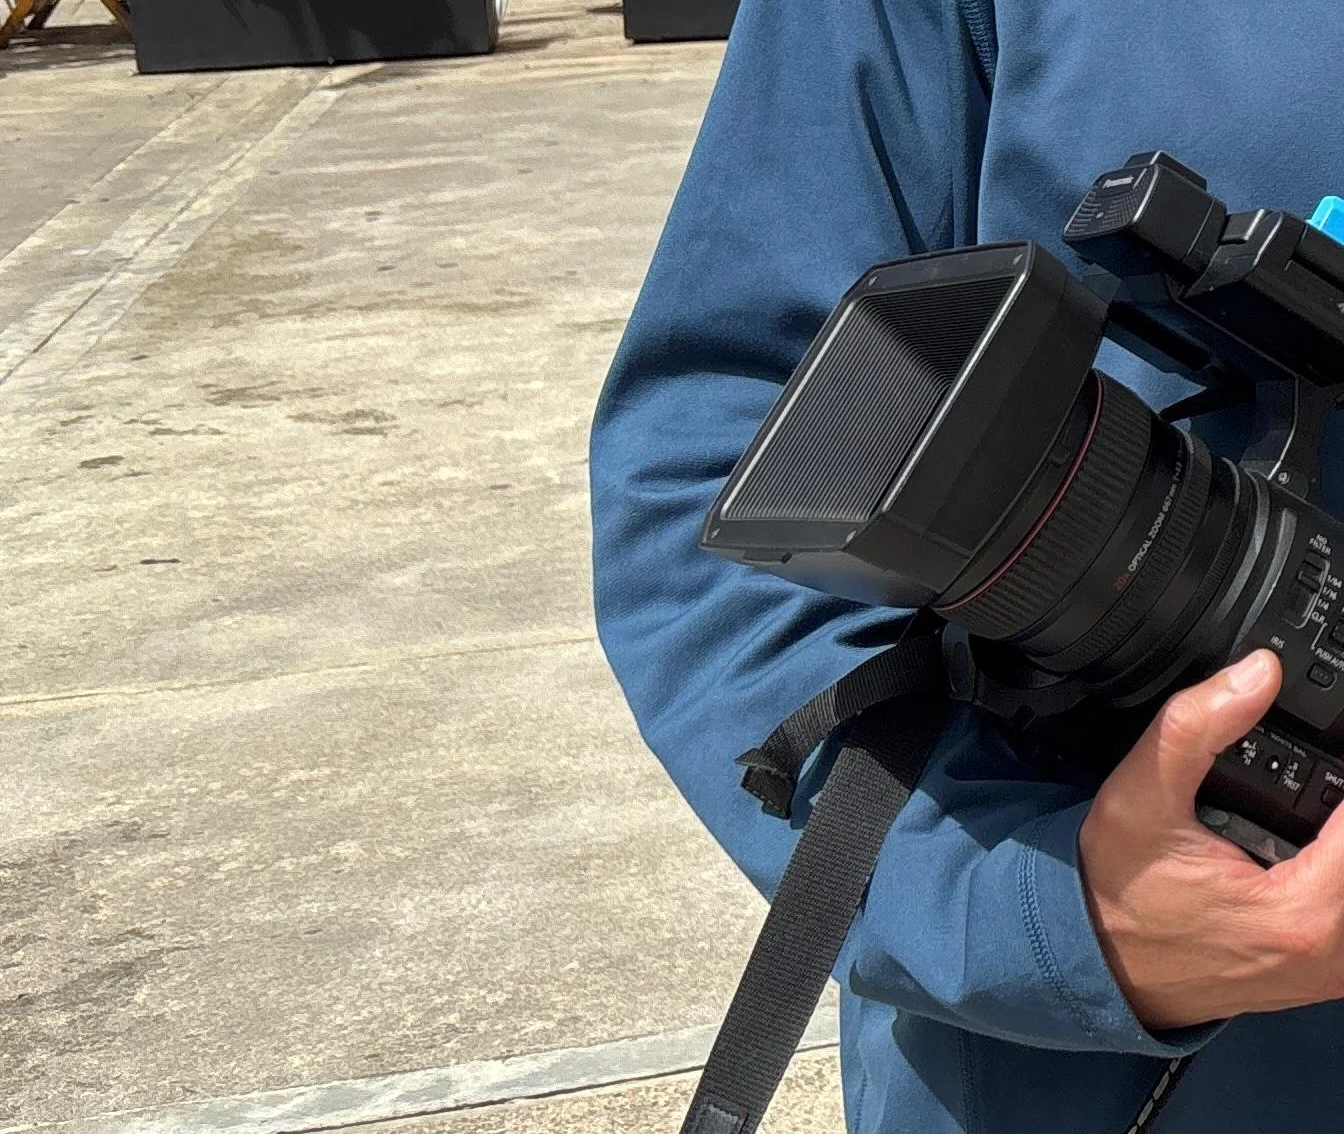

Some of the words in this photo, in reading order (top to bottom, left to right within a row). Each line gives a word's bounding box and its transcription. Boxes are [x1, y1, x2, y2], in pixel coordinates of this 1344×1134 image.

[1128, 540, 1152, 572] OPTICAL
[1147, 512, 1166, 539] ZOOM
[1308, 538, 1332, 555] FILTER
